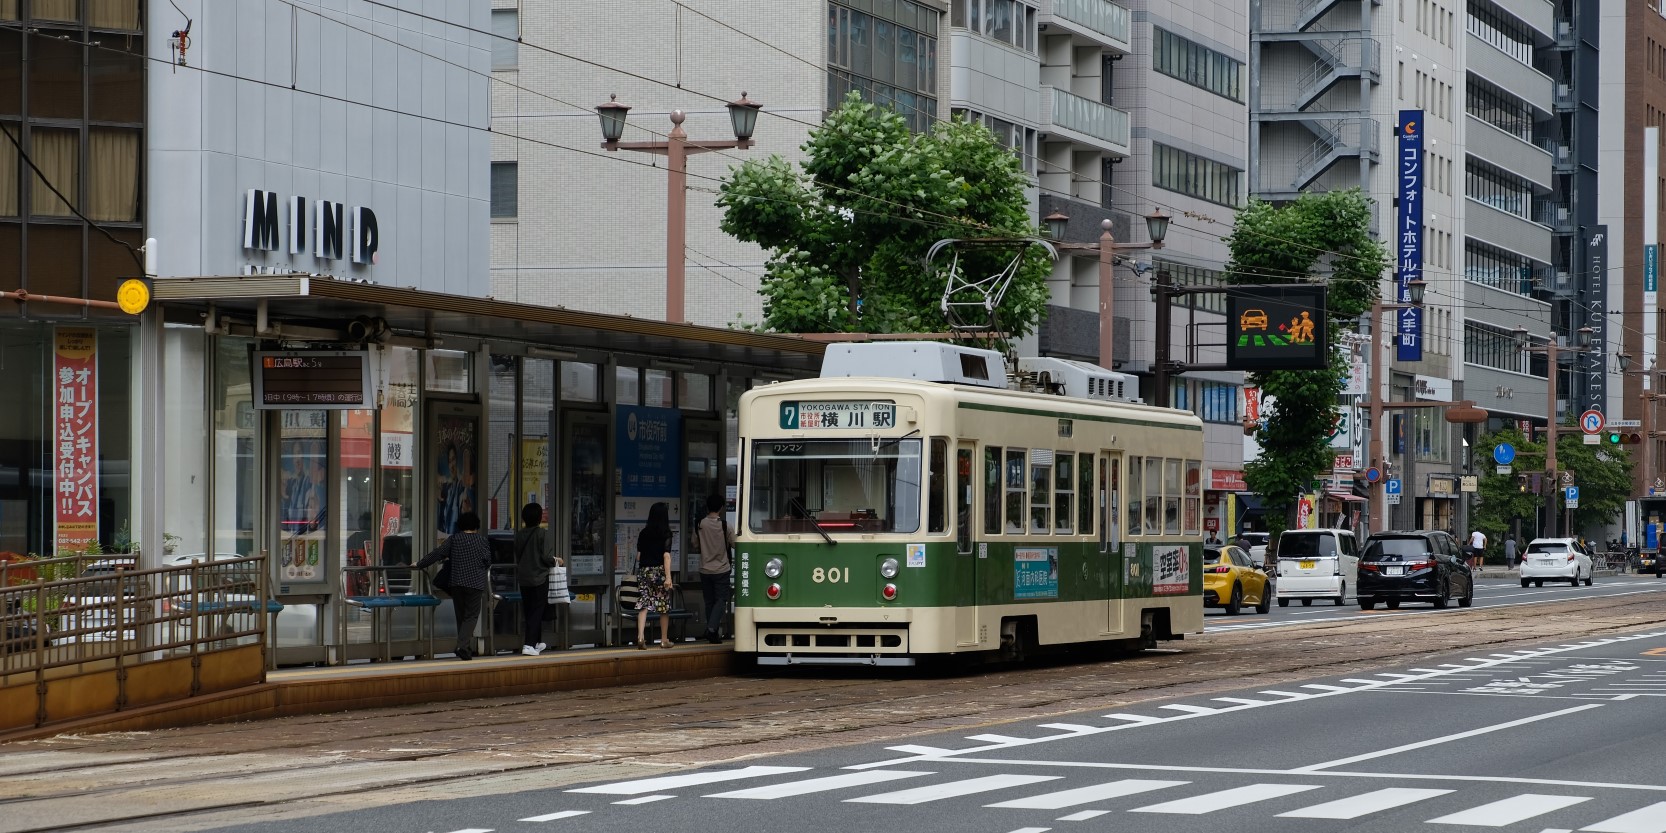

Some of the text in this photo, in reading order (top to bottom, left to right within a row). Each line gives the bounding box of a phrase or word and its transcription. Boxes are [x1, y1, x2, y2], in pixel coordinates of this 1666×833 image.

[1592, 256, 1600, 295] HOTEL
[784, 406, 795, 426] 7
[800, 412, 820, 420] 市役所
[800, 420, 820, 428] 紙屋町
[821, 412, 890, 428] 横川駅
[639, 419, 668, 442] 市役所前
[59, 366, 75, 515] 参加申込受付中!!
[75, 367, 93, 517] オープンキャンパス
[773, 444, 803, 452] ワンマン
[1335, 456, 1353, 468] たばこ
[1389, 480, 1398, 492] P
[1568, 489, 1576, 498] P
[741, 552, 749, 597] 乗降者優先
[812, 567, 849, 583] 801
[1130, 563, 1140, 577] 801
